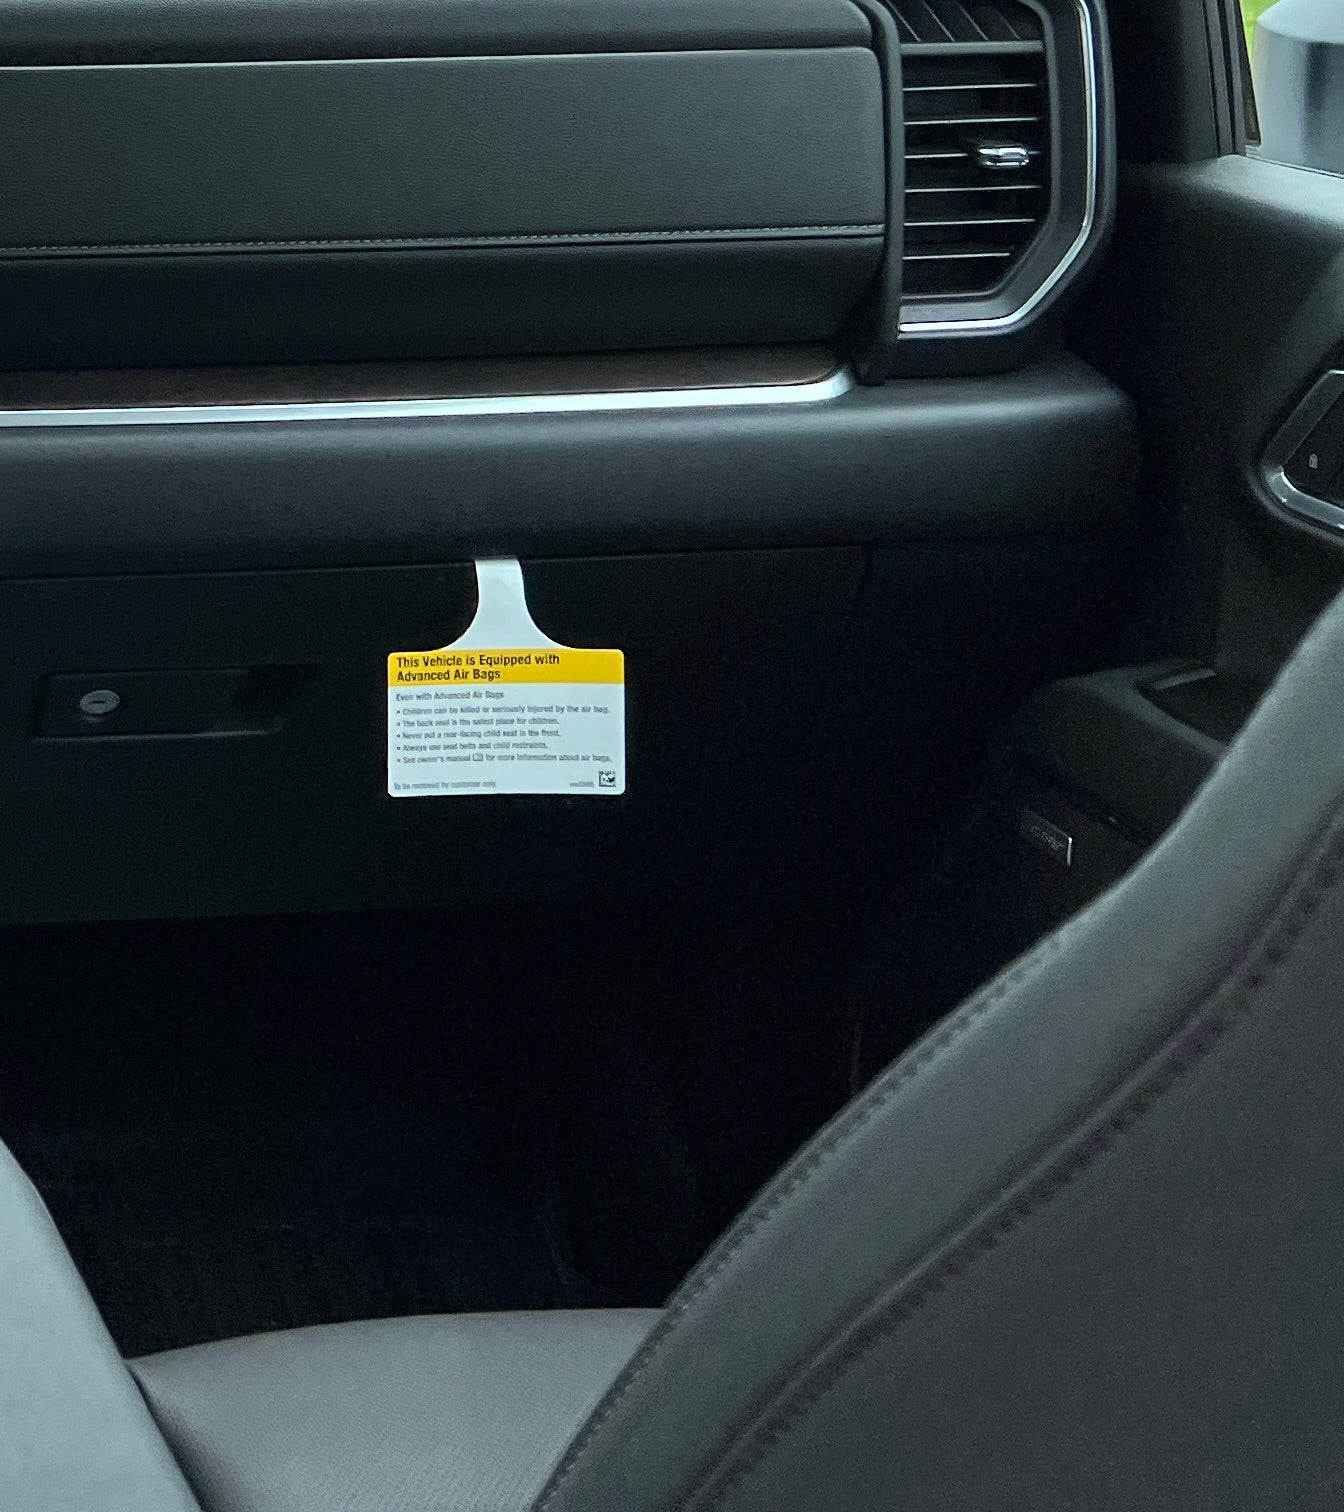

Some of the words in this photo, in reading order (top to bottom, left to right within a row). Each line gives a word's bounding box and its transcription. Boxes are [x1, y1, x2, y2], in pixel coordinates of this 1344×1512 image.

[396, 657, 420, 668] This
[422, 655, 463, 667] Vehicle
[465, 655, 476, 666] is
[479, 654, 532, 667] Equipped
[534, 654, 560, 665] with
[397, 670, 451, 682] Advanced
[453, 669, 470, 680] Air
[473, 669, 501, 682] Bags
[396, 693, 415, 701] Even
[433, 692, 471, 700] Advanced
[472, 691, 483, 699] Air
[485, 691, 504, 700] Bags
[460, 706, 481, 714] killed
[492, 706, 525, 714] seriously
[527, 706, 553, 714] injured
[555, 706, 565, 714] by
[566, 705, 579, 713] the
[435, 719, 450, 727] seat
[472, 718, 494, 726] safest
[495, 718, 515, 726] place
[443, 730, 482, 739] rear-facing
[403, 744, 427, 752] Always
[442, 743, 458, 751] seat
[493, 741, 511, 749] child
[446, 754, 472, 762] manual
[516, 753, 558, 761] information
